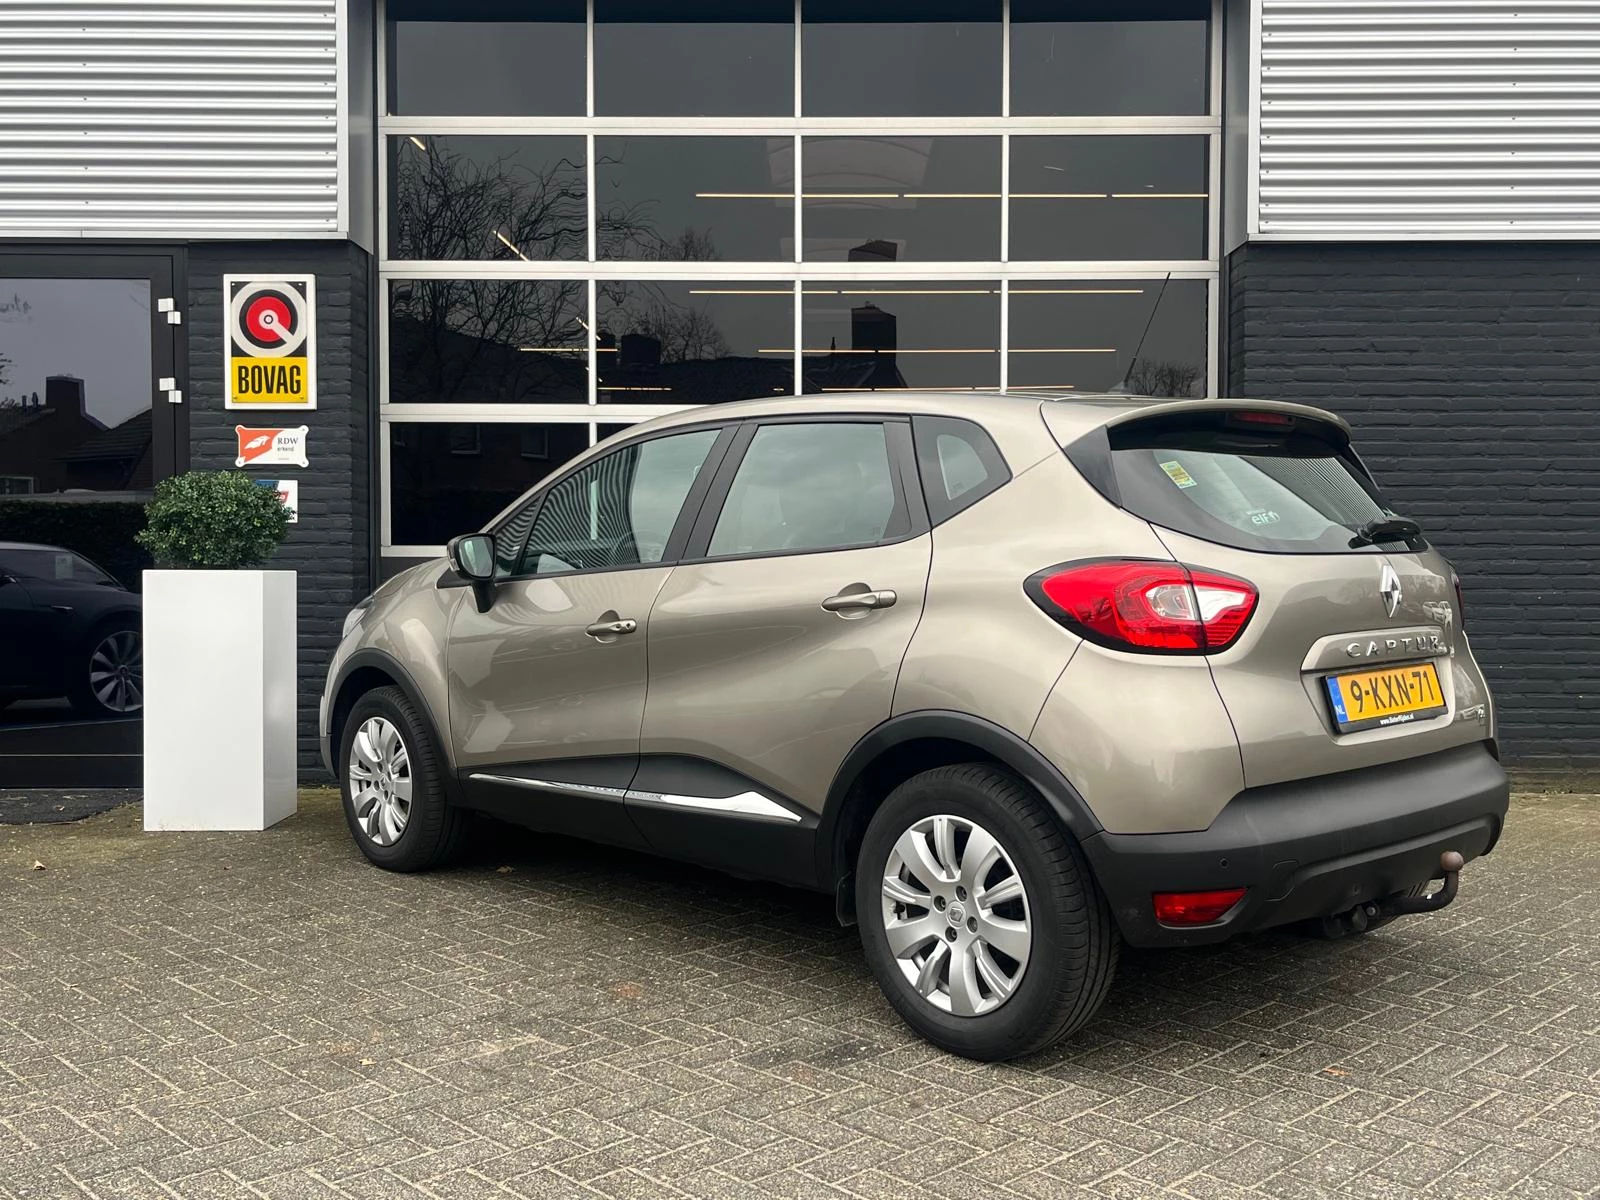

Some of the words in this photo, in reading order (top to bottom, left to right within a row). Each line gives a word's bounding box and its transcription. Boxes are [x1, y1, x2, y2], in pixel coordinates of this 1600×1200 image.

[238, 365, 301, 394] BOVAG
[277, 436, 298, 445] RDW
[1346, 635, 1439, 658] CAPTUR
[1350, 671, 1434, 713] 9-KXN-71
[1335, 705, 1345, 715] NL
